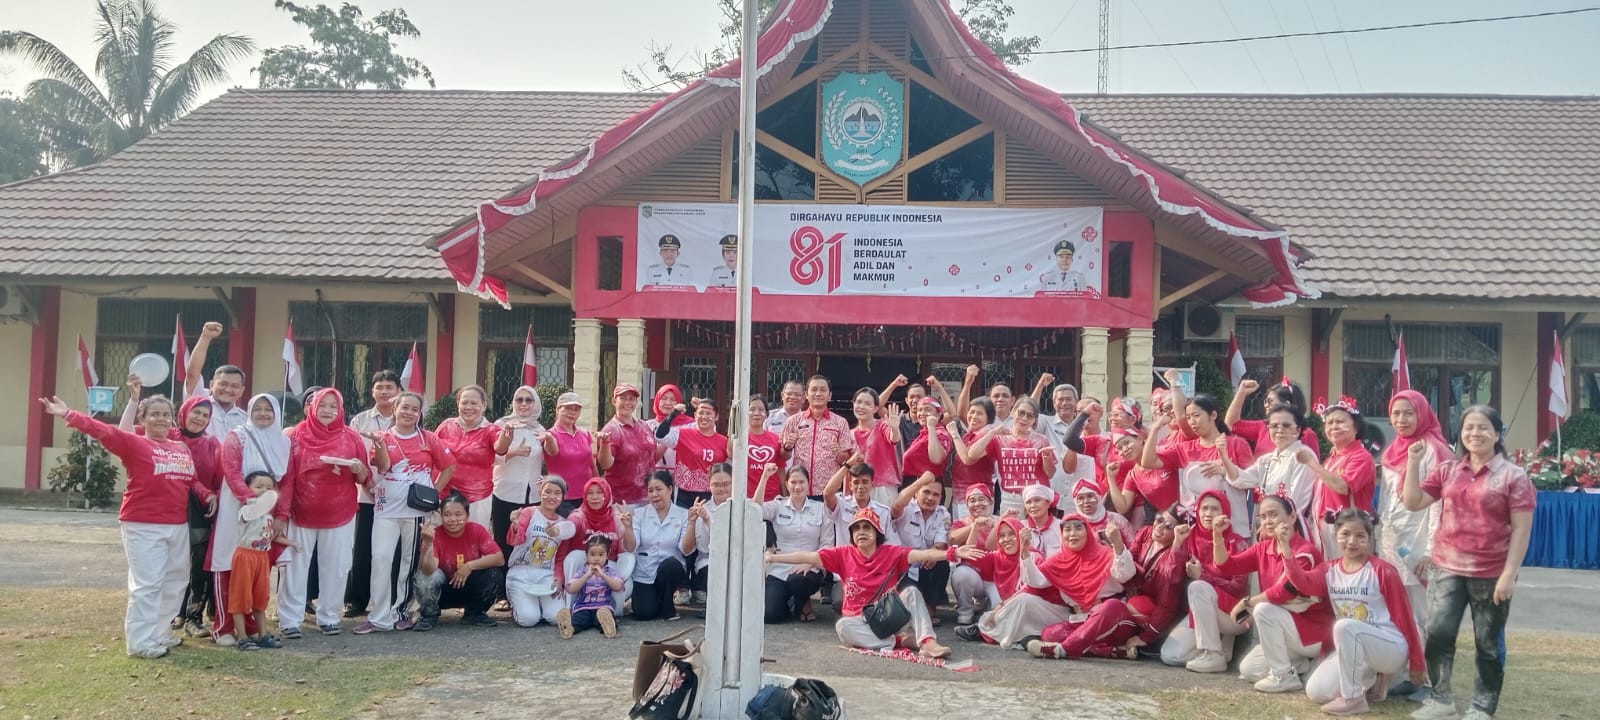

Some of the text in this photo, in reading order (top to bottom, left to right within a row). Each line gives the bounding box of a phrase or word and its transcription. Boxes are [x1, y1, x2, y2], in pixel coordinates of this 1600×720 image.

[790, 213, 943, 223] DIRGAHAYU REPUBLIK INDONESIA
[854, 238, 903, 247] INDONESIA
[854, 250, 907, 259] BERDAULAT
[790, 226, 848, 294] 81
[853, 261, 895, 270] ADIL DAN
[853, 273, 895, 282] MAKMUR
[96, 391, 106, 404] P
[702, 448, 714, 461] 13
